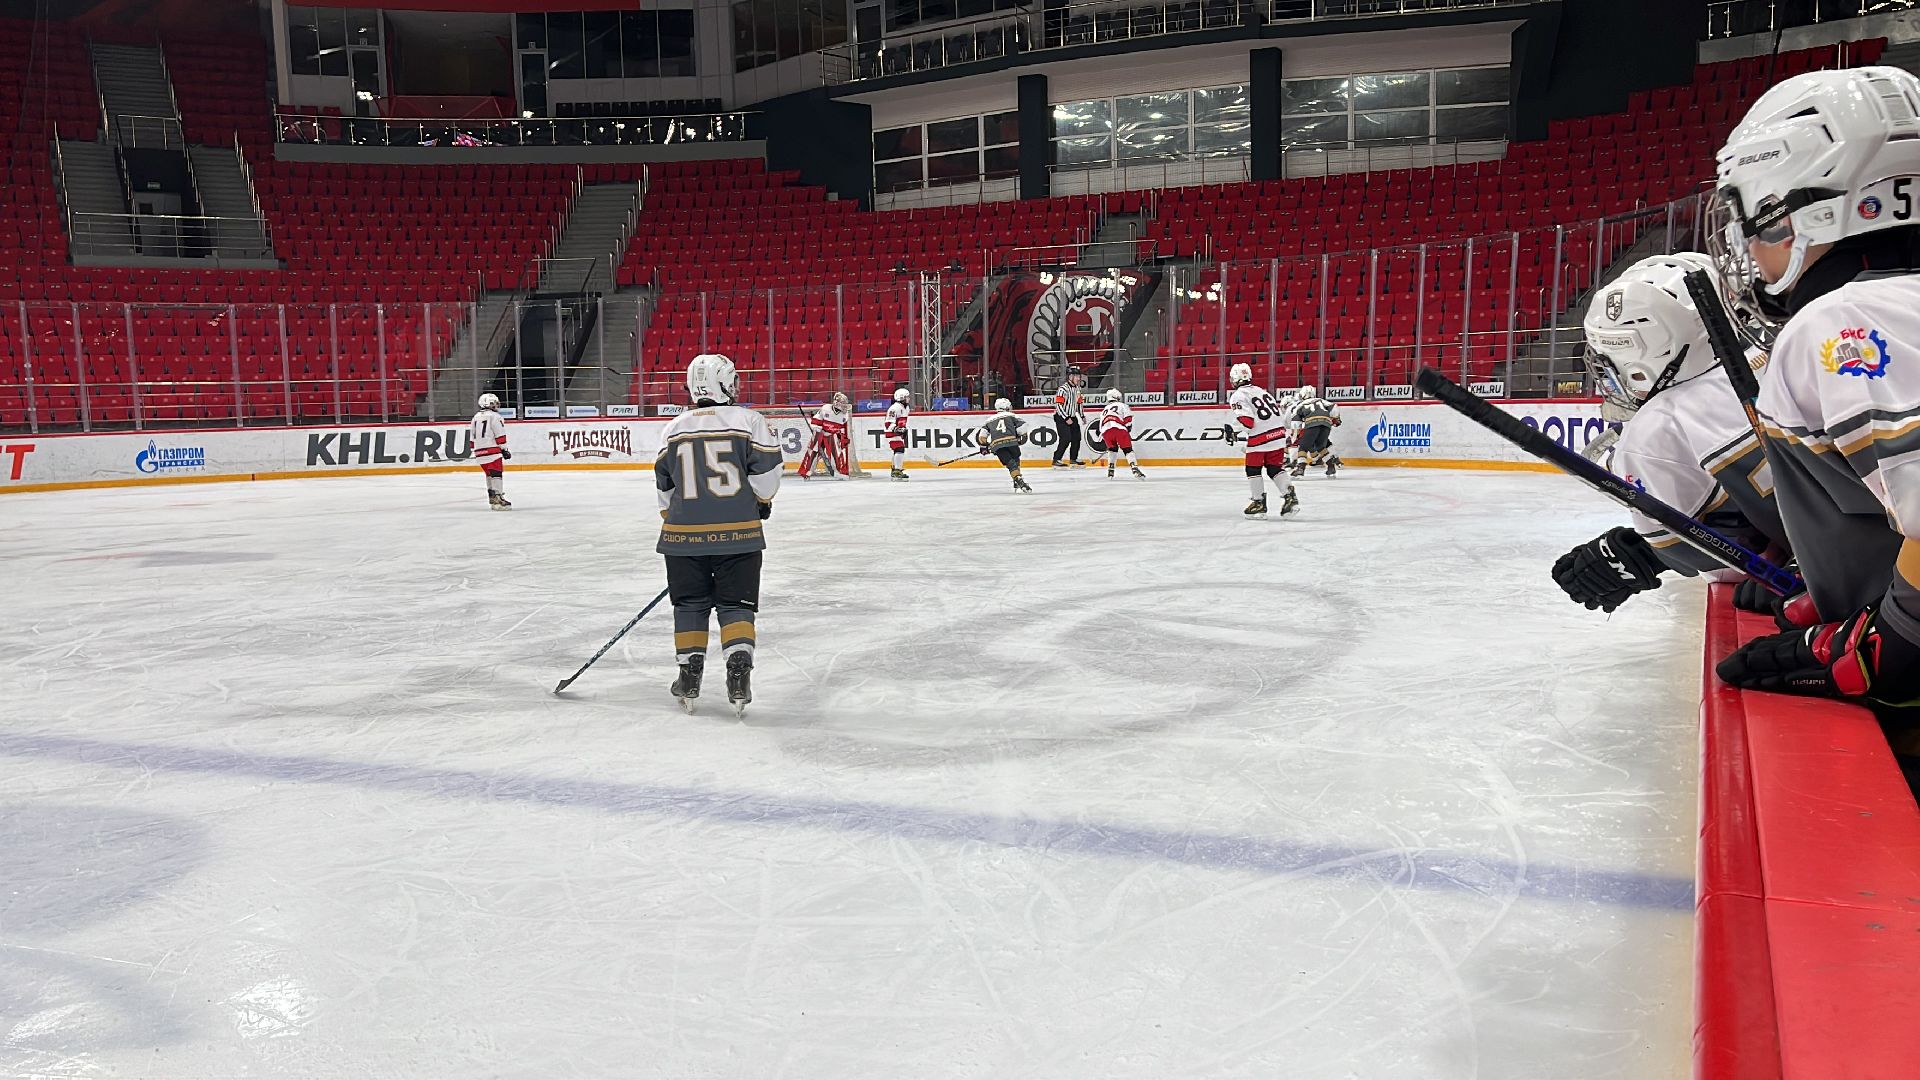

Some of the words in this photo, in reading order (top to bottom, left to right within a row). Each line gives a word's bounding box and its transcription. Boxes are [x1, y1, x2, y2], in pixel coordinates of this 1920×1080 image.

[1893, 177, 1912, 220] 5
[696, 386, 708, 396] 15
[1327, 388, 1362, 397] KHL.RU
[1376, 386, 1411, 398] KHL.RU
[1471, 383, 1501, 394] KHL.RU
[1083, 395, 1107, 404] HL.RU
[1127, 394, 1161, 403] KHL.RU
[1180, 392, 1215, 401] KHL.RU
[1252, 394, 1280, 421] 86
[995, 419, 1007, 433] 4
[1389, 424, 1431, 437] ГАЗПРОМ
[549, 426, 632, 456] ТУЛЬСКИЙ
[159, 447, 205, 460] ГАЗПРОМ
[306, 429, 473, 467] KHL.RU
[160, 459, 204, 467] ТРАНСГАЗ
[676, 440, 742, 500] 15
[1689, 525, 1742, 560] TRIGGER
